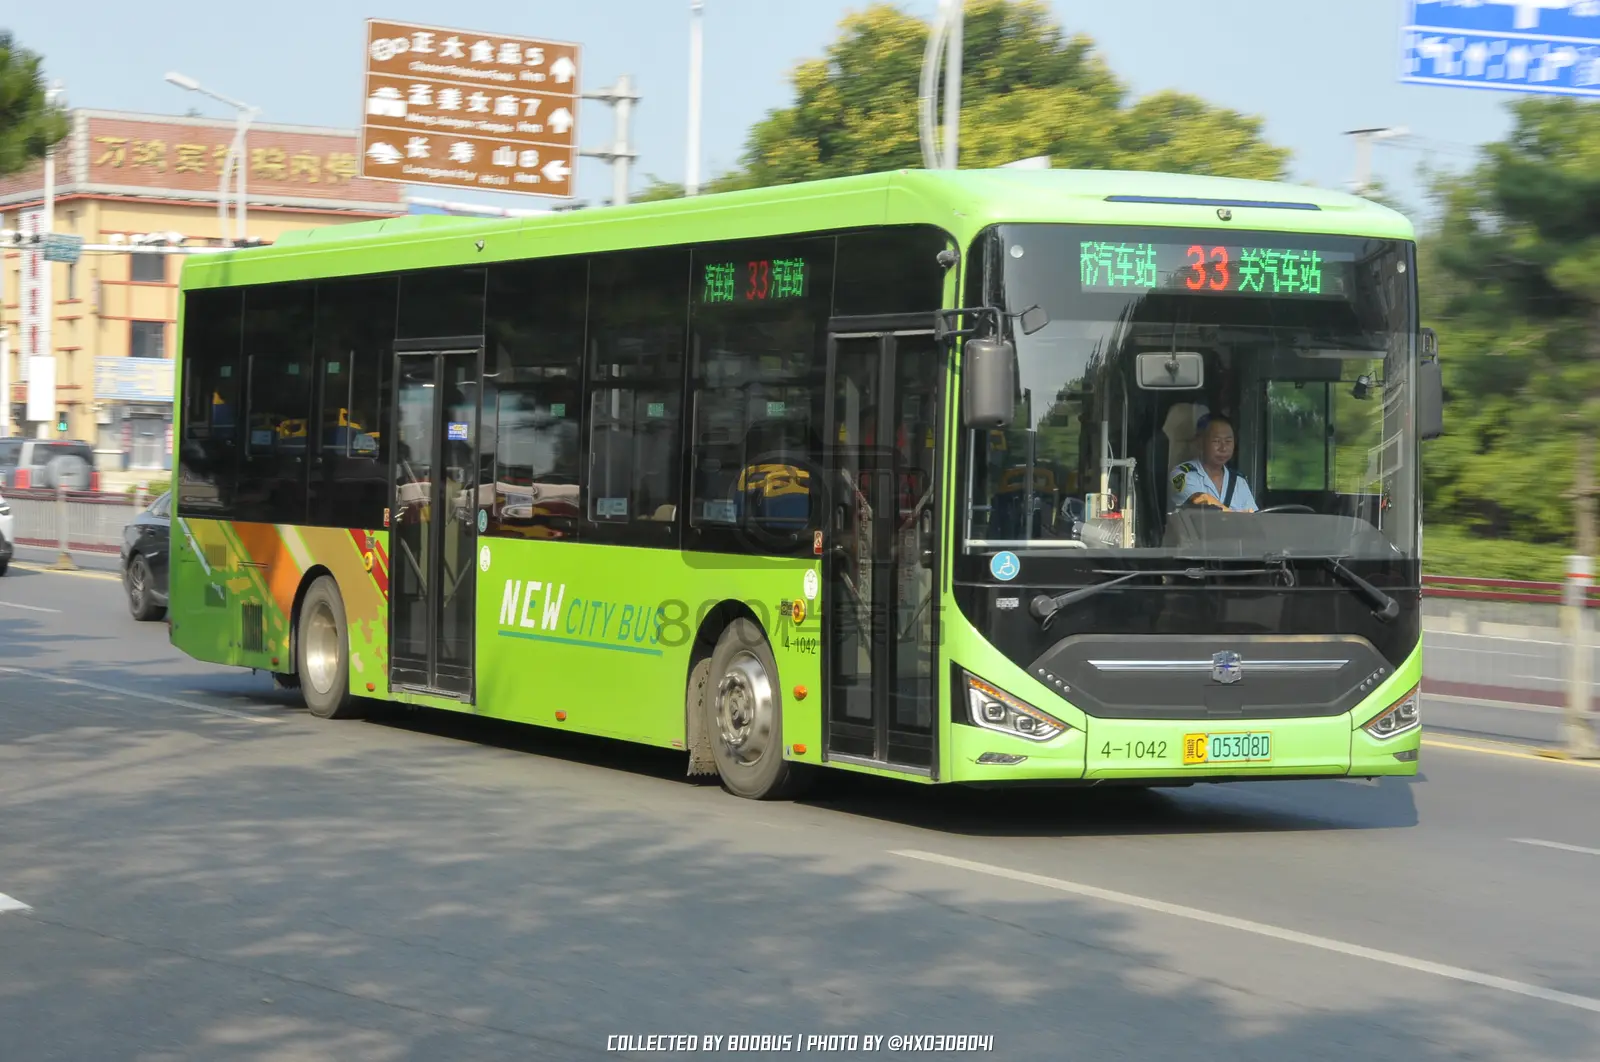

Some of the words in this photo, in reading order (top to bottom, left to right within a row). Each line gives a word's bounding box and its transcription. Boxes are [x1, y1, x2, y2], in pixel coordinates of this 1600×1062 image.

[746, 260, 769, 300] 33
[1186, 244, 1230, 291] 33
[1238, 247, 1322, 294] 关汽车站
[499, 579, 566, 631] NEW
[566, 598, 616, 638] CITY
[617, 604, 665, 645] BUS
[784, 635, 817, 655] 4-1042
[1101, 740, 1168, 759] 4-1042
